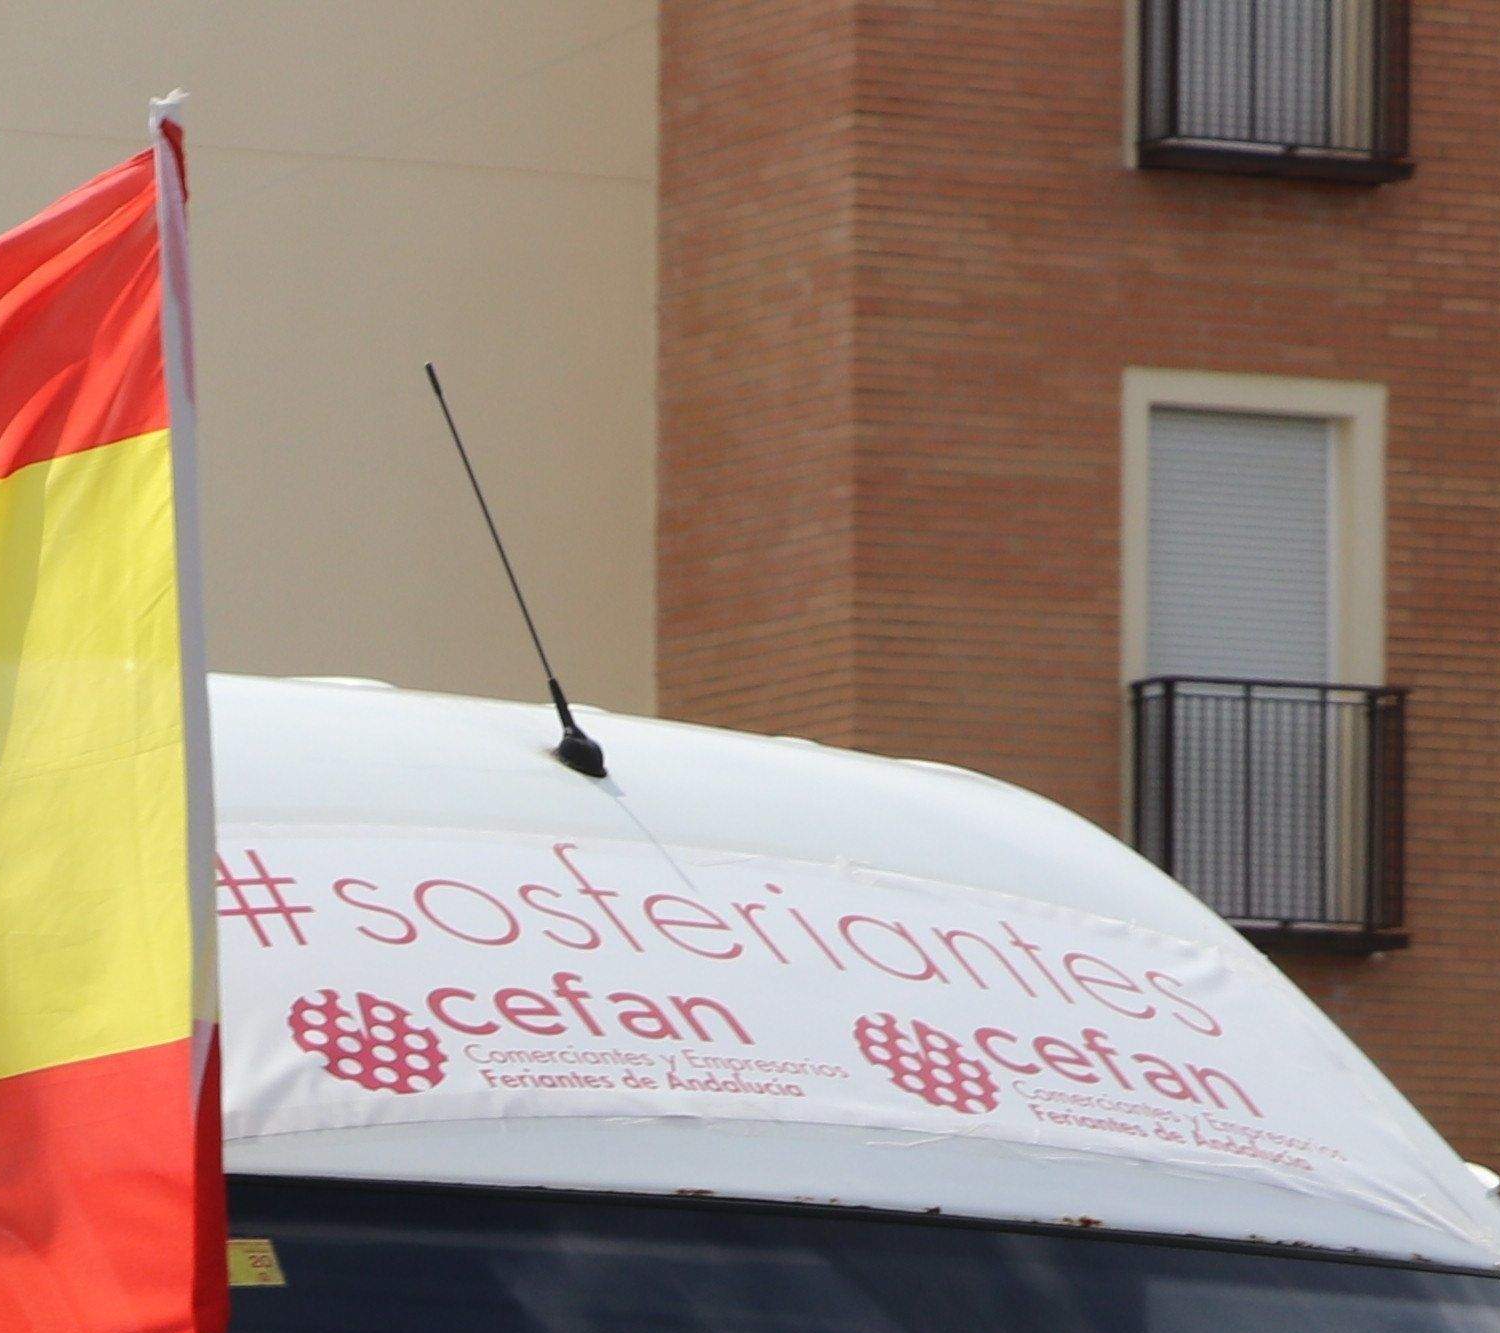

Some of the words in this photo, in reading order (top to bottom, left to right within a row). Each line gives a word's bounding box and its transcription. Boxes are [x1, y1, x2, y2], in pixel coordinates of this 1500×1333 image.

[216, 842, 1223, 1039] #sosferiantes
[426, 971, 755, 1045] cefan
[463, 1043, 656, 1067] Comerciantes
[660, 1053, 676, 1072] y
[682, 1048, 850, 1080] Empresarios
[479, 1068, 615, 1090] Feriantes
[622, 1069, 658, 1090] de
[973, 1026, 1264, 1118] cefan
